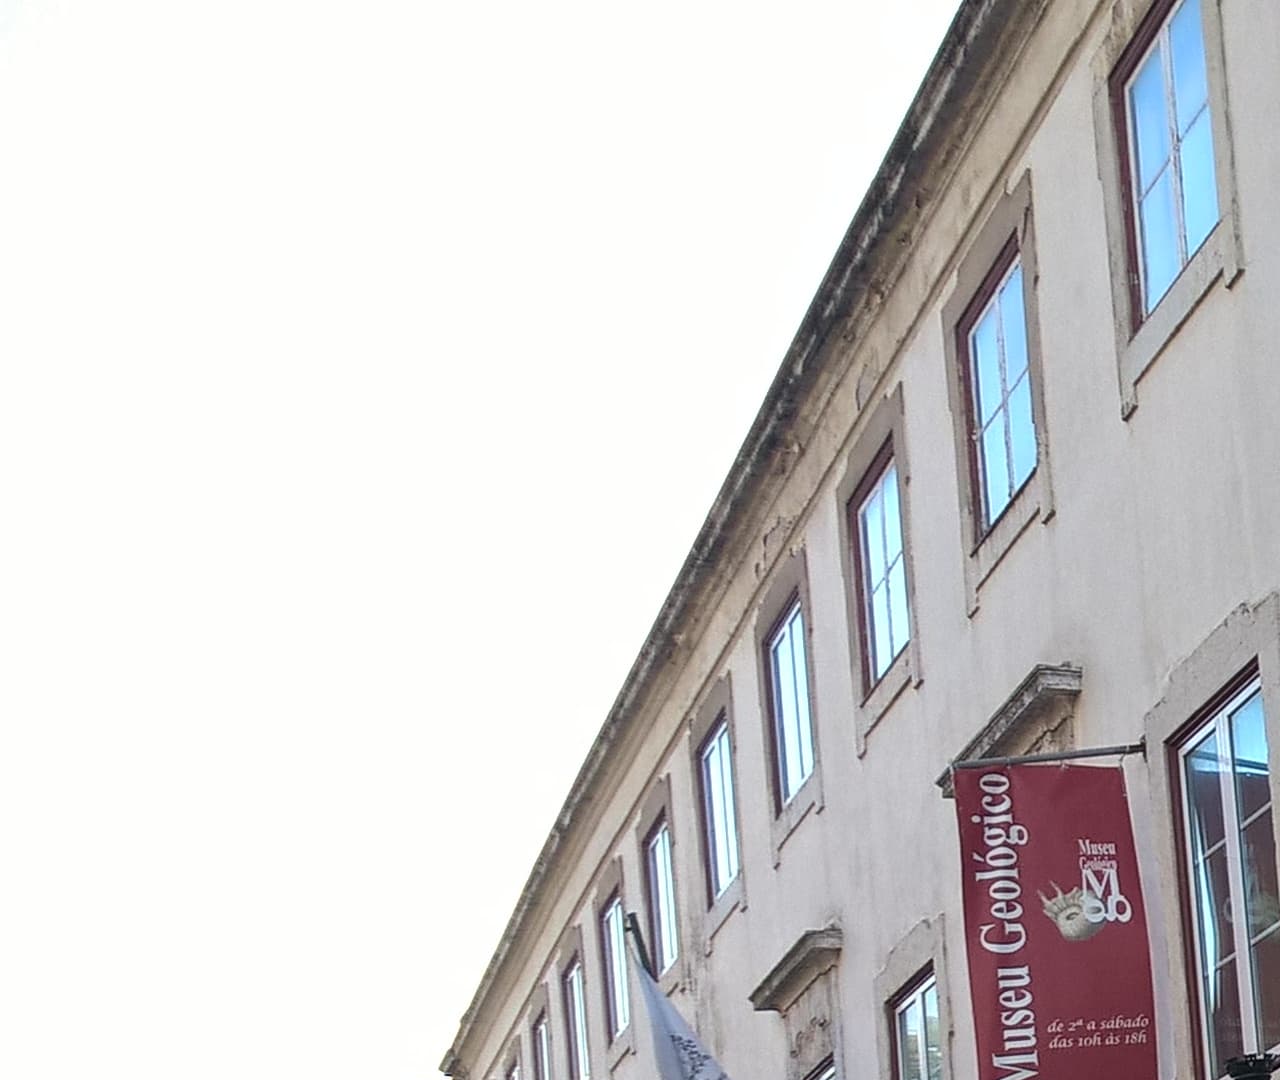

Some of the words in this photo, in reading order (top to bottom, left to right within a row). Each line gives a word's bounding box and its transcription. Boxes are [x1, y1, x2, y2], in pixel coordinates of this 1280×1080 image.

[1078, 839, 1116, 856] Museu
[971, 772, 1029, 954] Geológico
[1047, 1016, 1065, 1034] de
[1086, 1020, 1096, 1031] a
[1100, 1013, 1149, 1031] sábado
[1049, 1033, 1073, 1049] das
[1078, 1031, 1100, 1048] 10h
[1124, 1030, 1147, 1045] 18h
